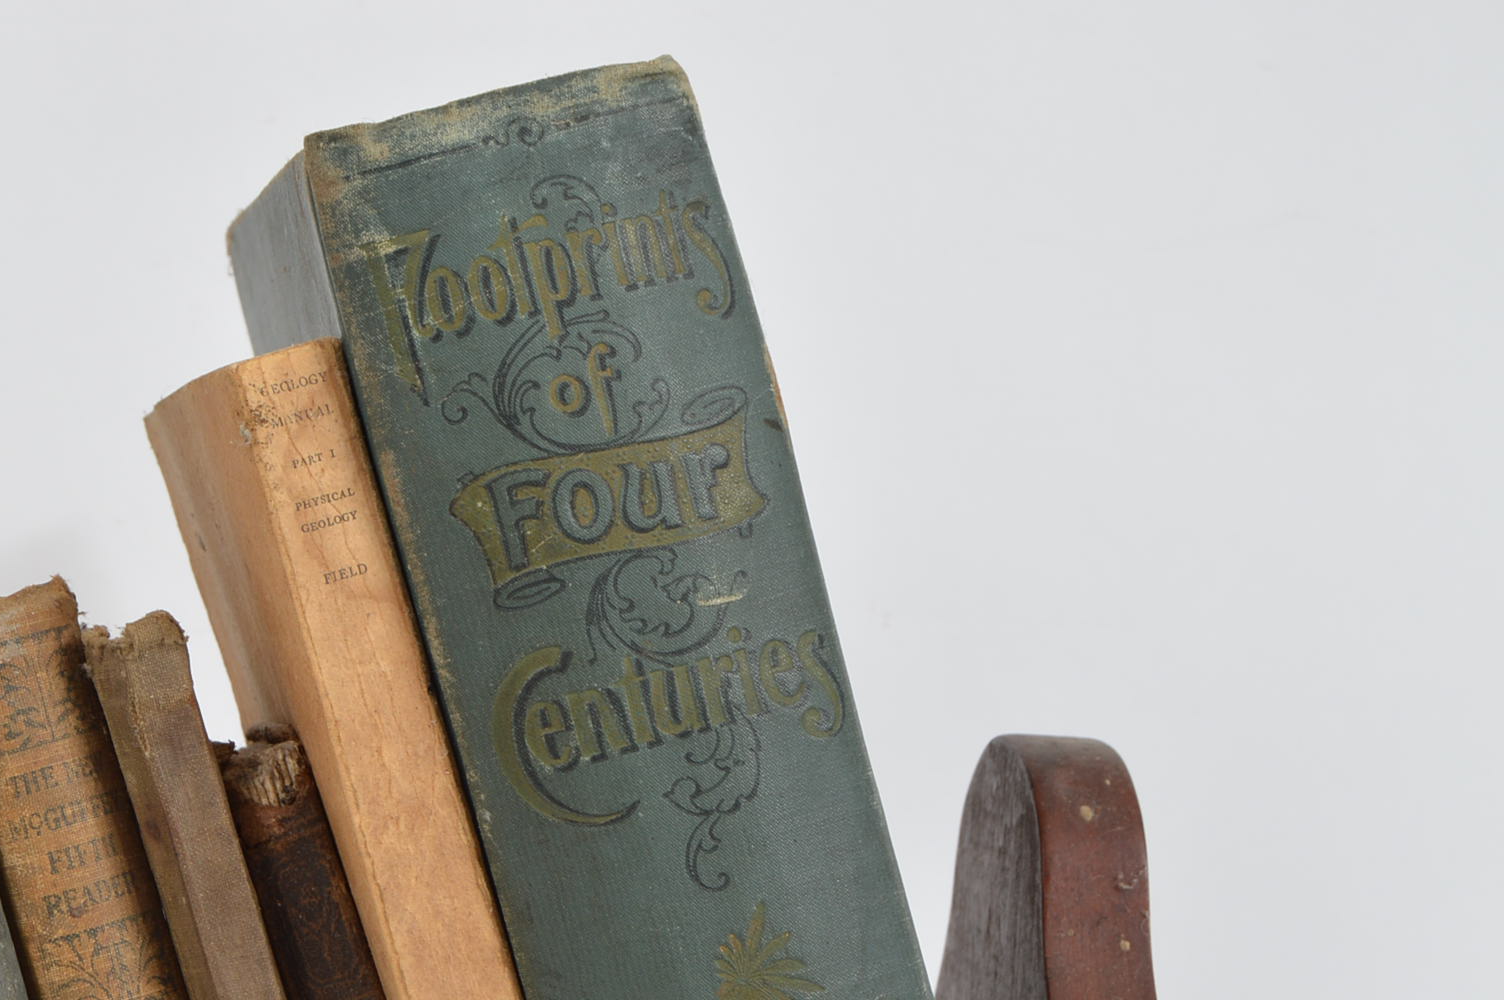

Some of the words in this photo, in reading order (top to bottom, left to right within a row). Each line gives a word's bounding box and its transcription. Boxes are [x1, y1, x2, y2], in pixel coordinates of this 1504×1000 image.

[260, 371, 327, 397] GEOLOGY
[550, 342, 622, 437] of
[292, 453, 323, 469] PART
[330, 449, 336, 459] I
[295, 487, 355, 511] PHYSICAL
[301, 510, 358, 534] GEOLOGY
[323, 563, 368, 585] FIELD
[497, 625, 845, 827] Centuries
[9, 765, 58, 799] THE
[44, 870, 137, 918] READER
